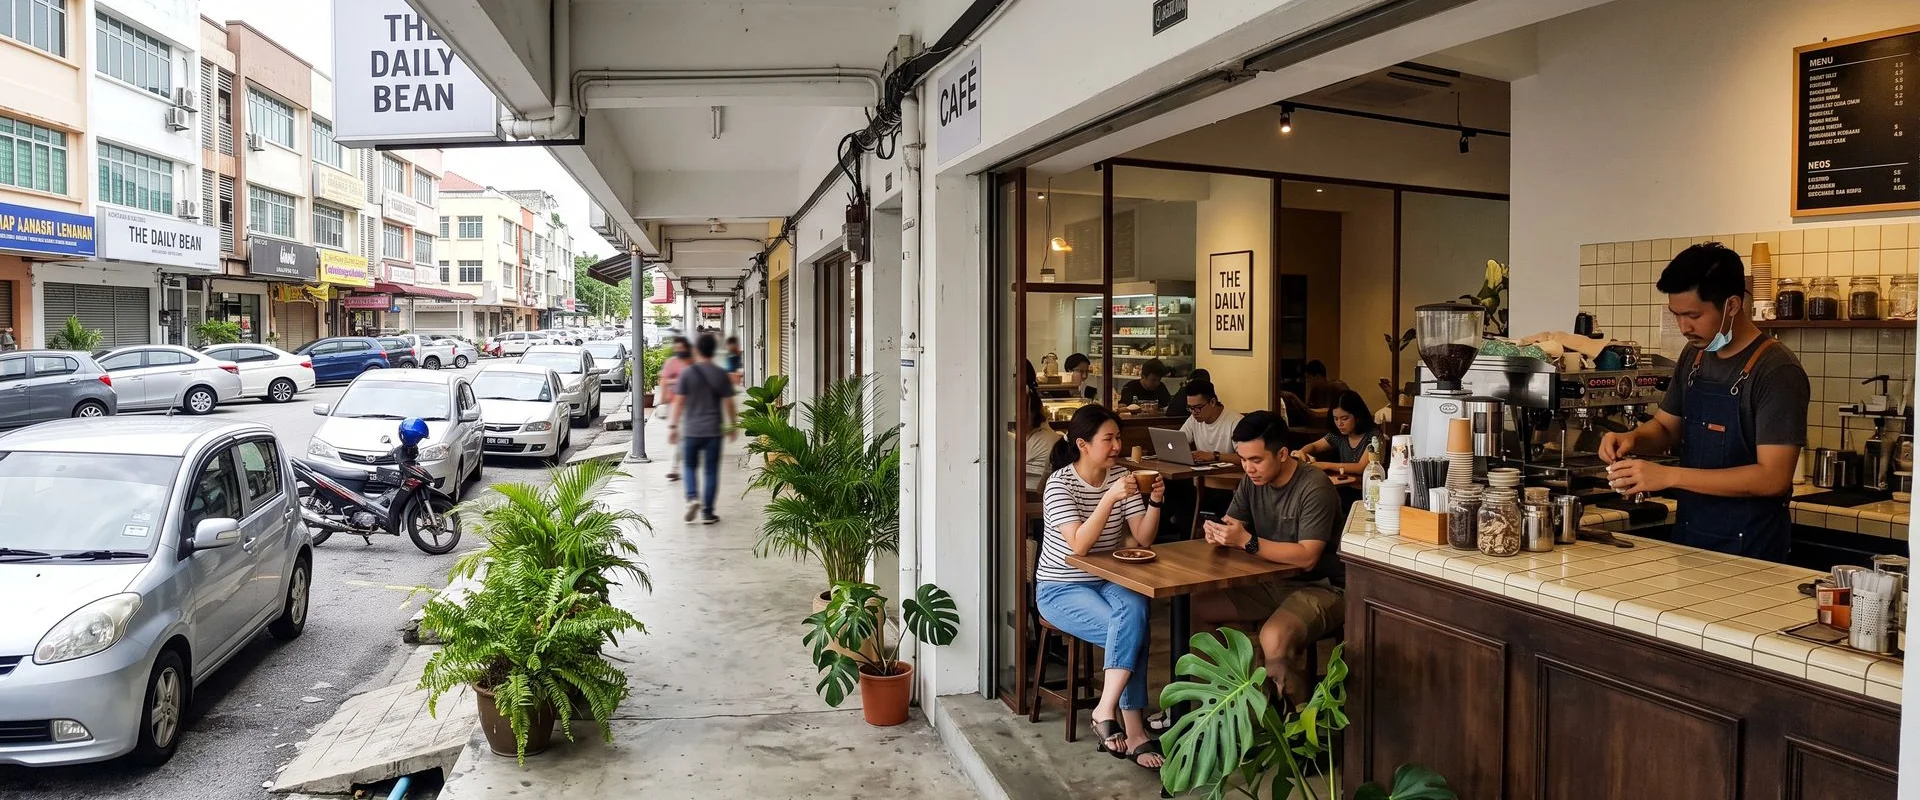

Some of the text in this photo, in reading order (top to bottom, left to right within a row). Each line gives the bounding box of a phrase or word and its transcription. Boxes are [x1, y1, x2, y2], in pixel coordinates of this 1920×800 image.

[371, 48, 455, 78] DAILY
[1809, 56, 1834, 67] MENU
[373, 83, 454, 113] BEAN
[940, 59, 977, 127] CAFÉ
[1808, 159, 1831, 170] NEOS
[129, 225, 202, 251] THE DAILY BEAN
[1220, 270, 1240, 288] THE
[1215, 292, 1246, 310] DAILY
[1216, 314, 1245, 332] BEAN
